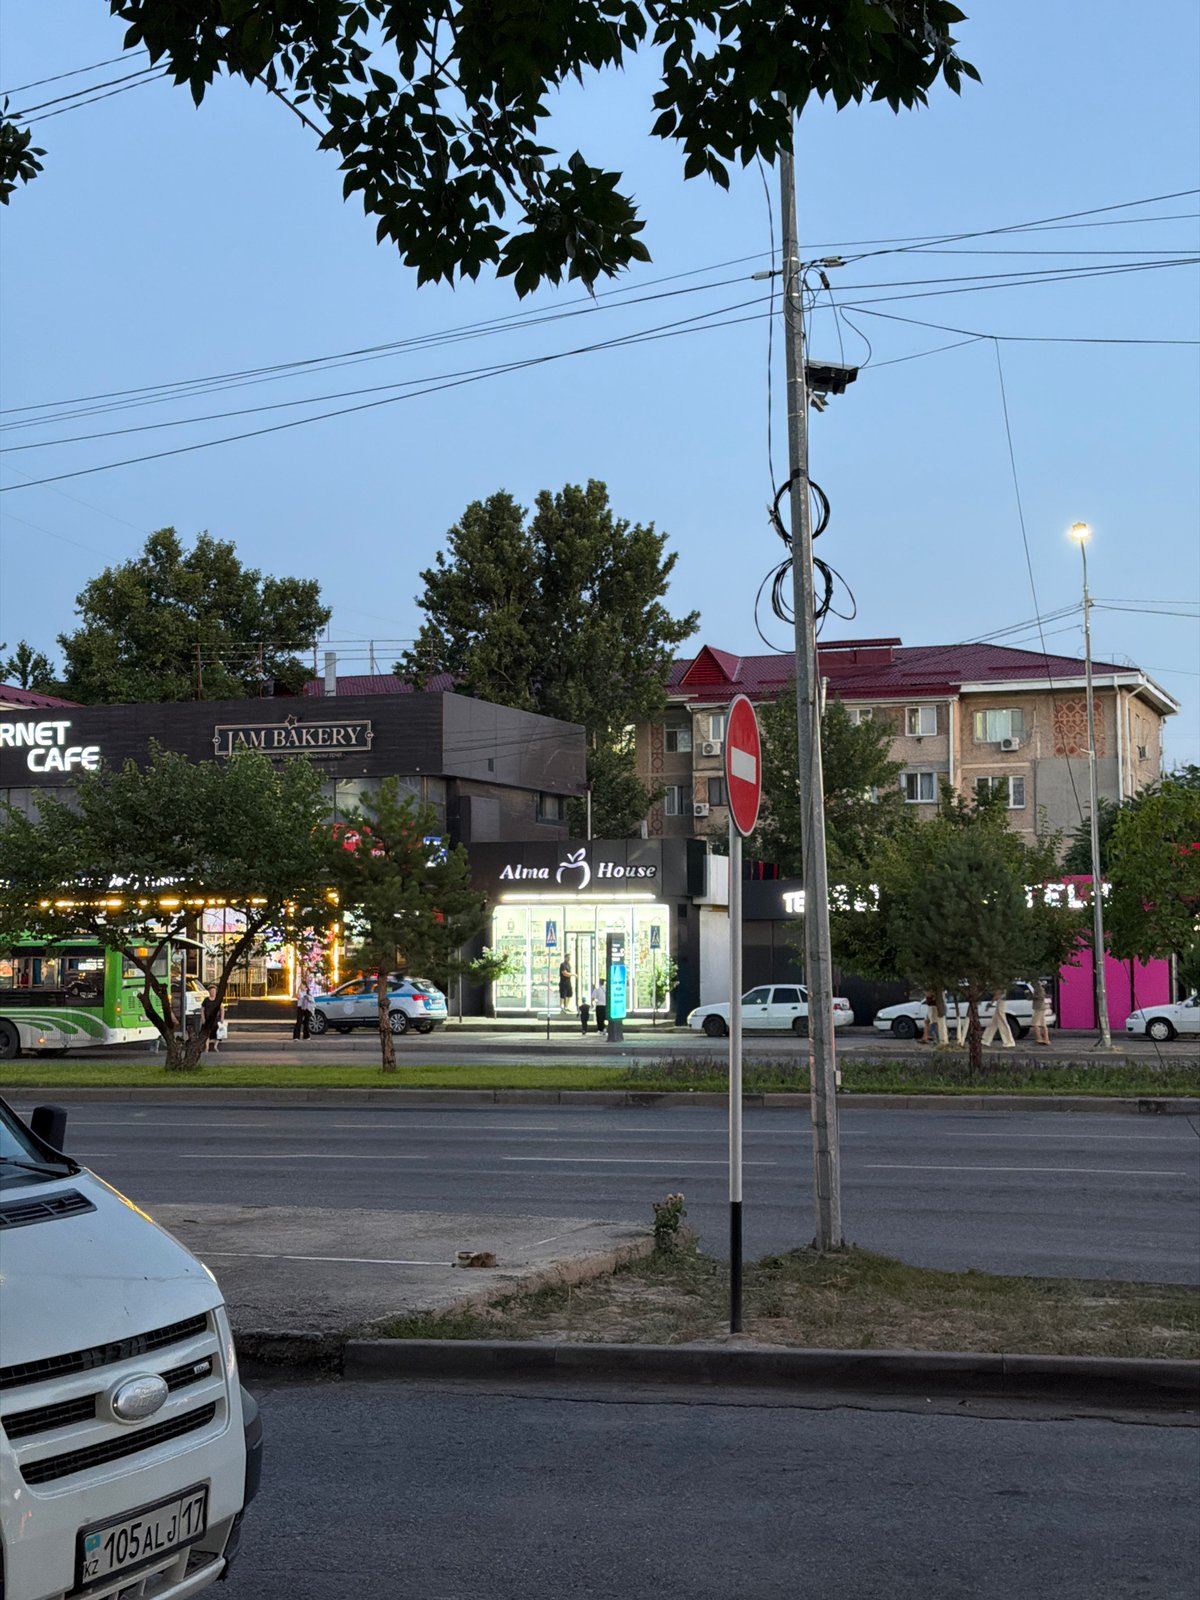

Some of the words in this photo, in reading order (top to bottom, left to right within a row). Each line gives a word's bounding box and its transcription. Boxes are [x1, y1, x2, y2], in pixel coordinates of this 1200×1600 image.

[0, 721, 71, 747] RNET
[226, 730, 266, 757] JAM
[273, 727, 361, 747] BAKERY
[27, 746, 100, 772] CAFE
[499, 864, 549, 880] Alma
[597, 862, 656, 879] House
[84, 1559, 99, 1577] KZ
